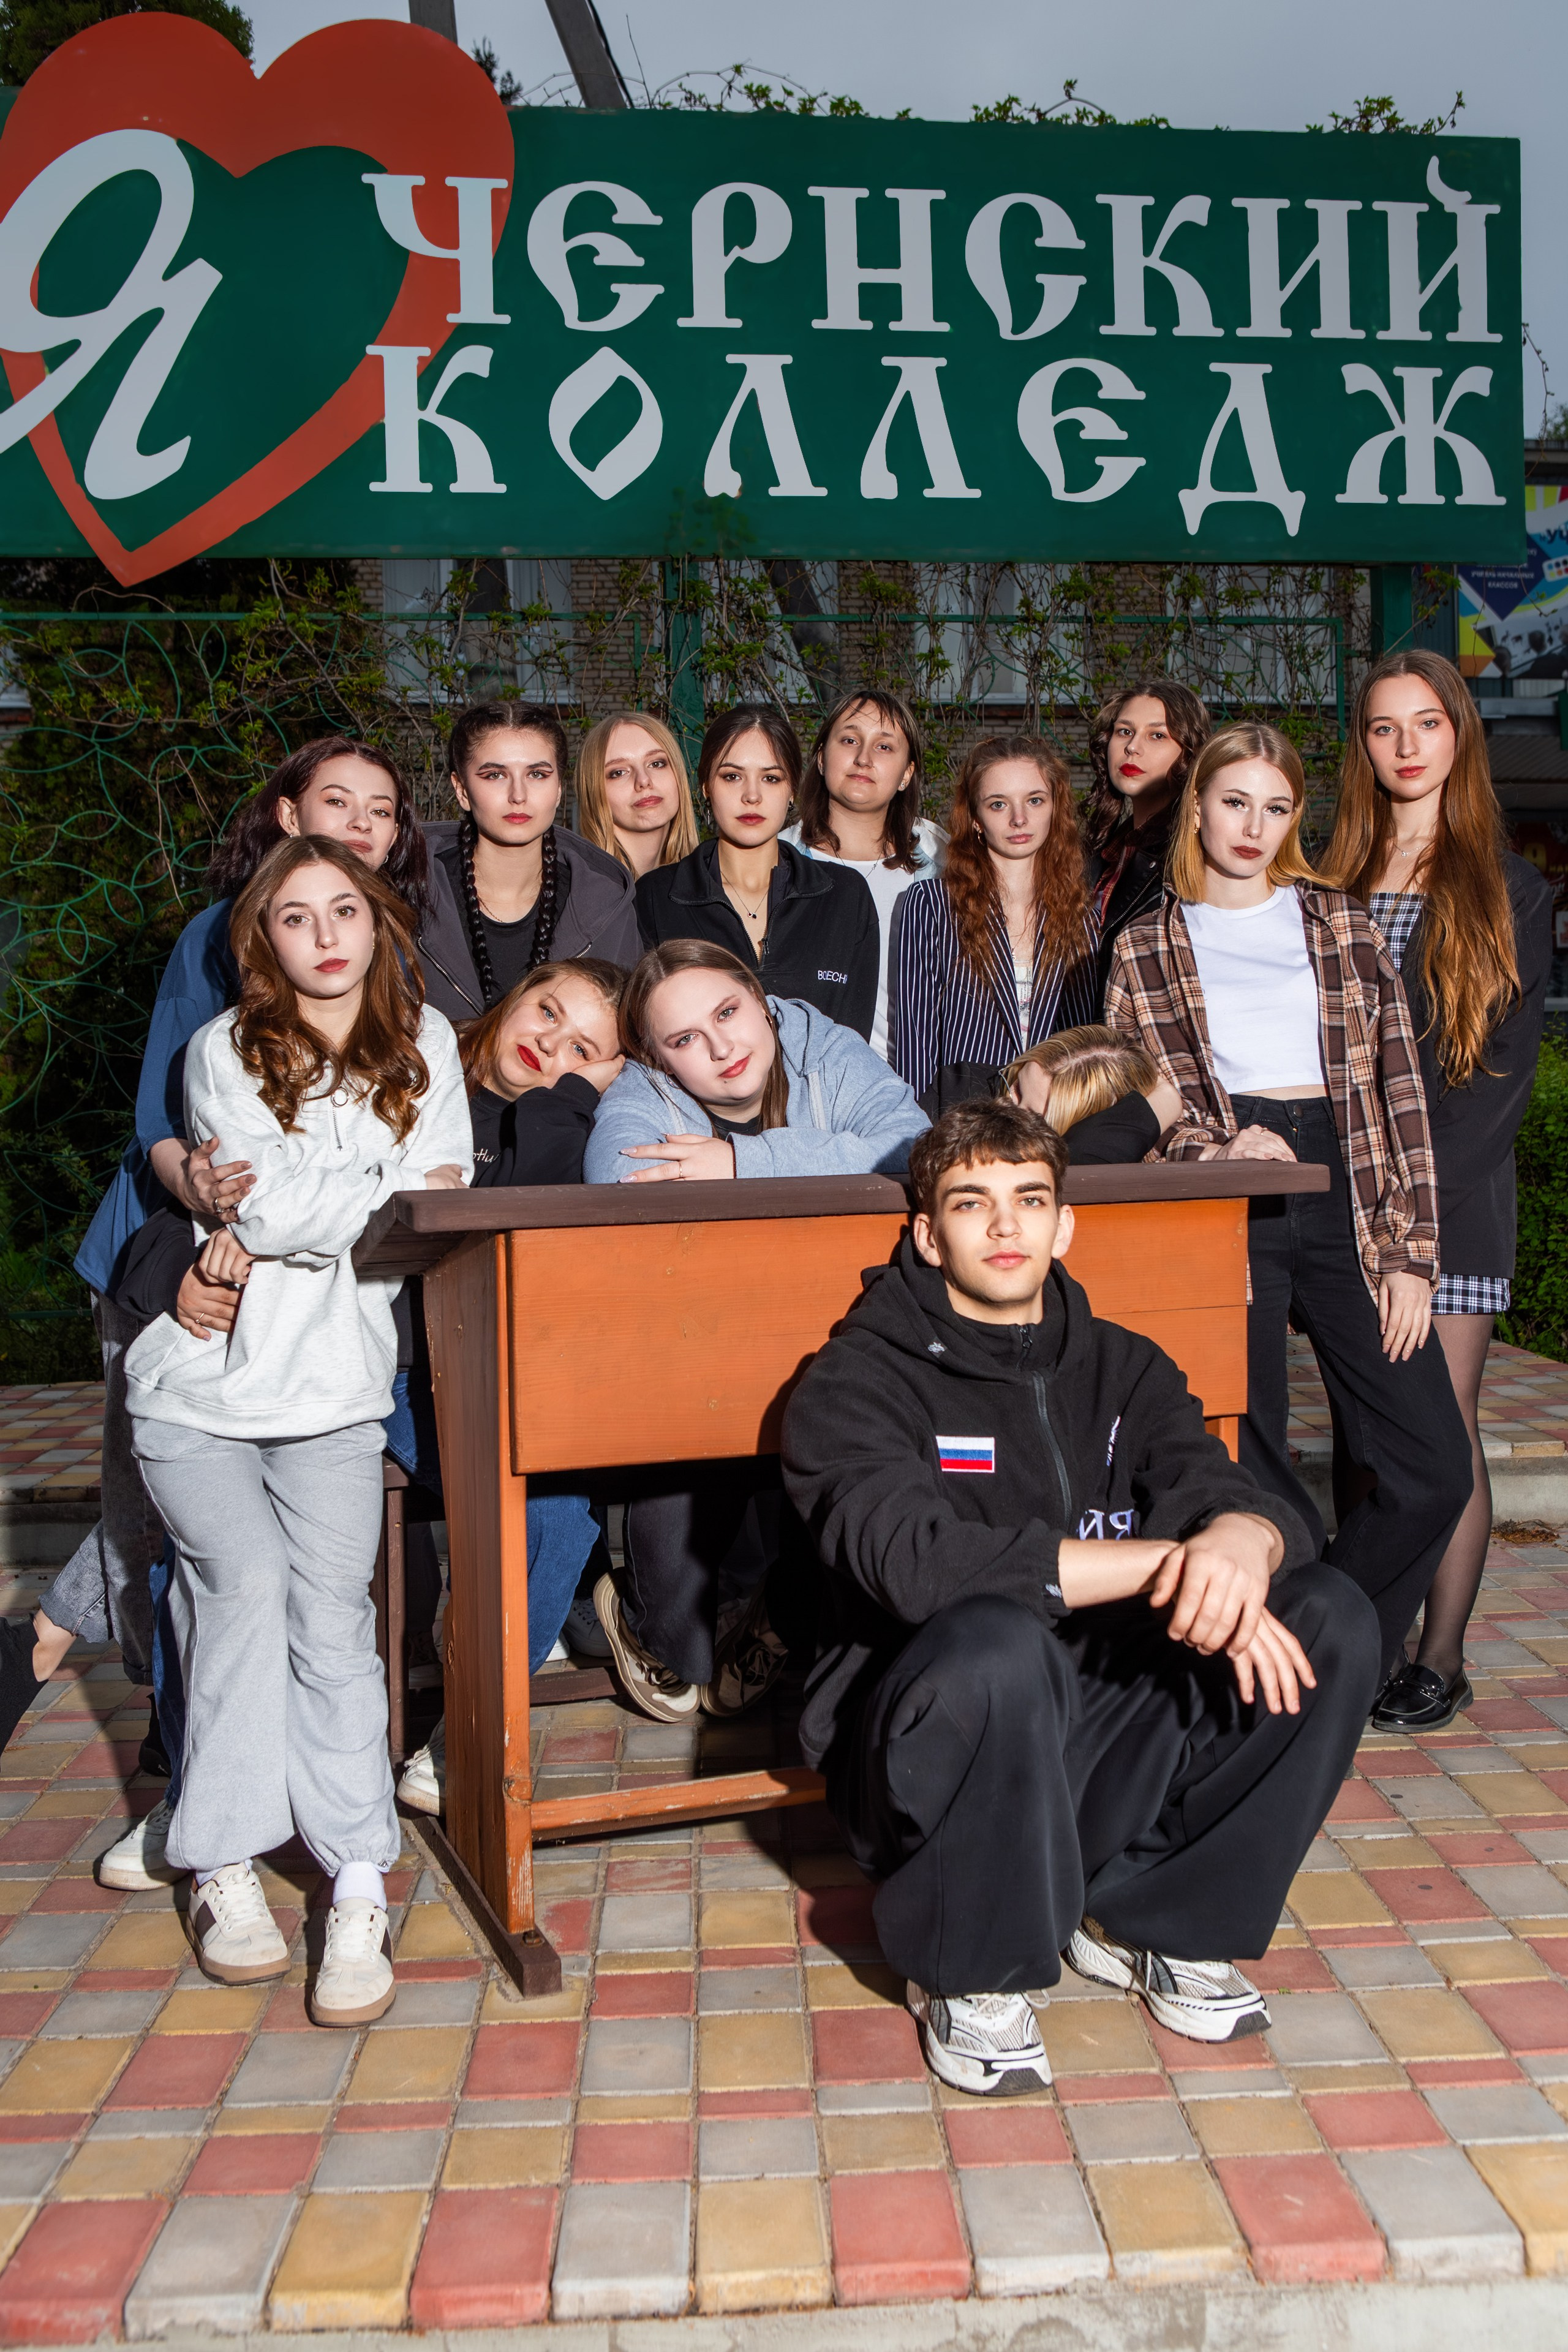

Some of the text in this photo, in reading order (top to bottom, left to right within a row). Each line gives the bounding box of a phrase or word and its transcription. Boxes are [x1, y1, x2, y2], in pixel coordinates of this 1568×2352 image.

[0, 129, 222, 499] Я
[362, 156, 1502, 342] ЧЕРНСКИЙ
[366, 345, 1506, 536] КОЛЛЕДЖ
